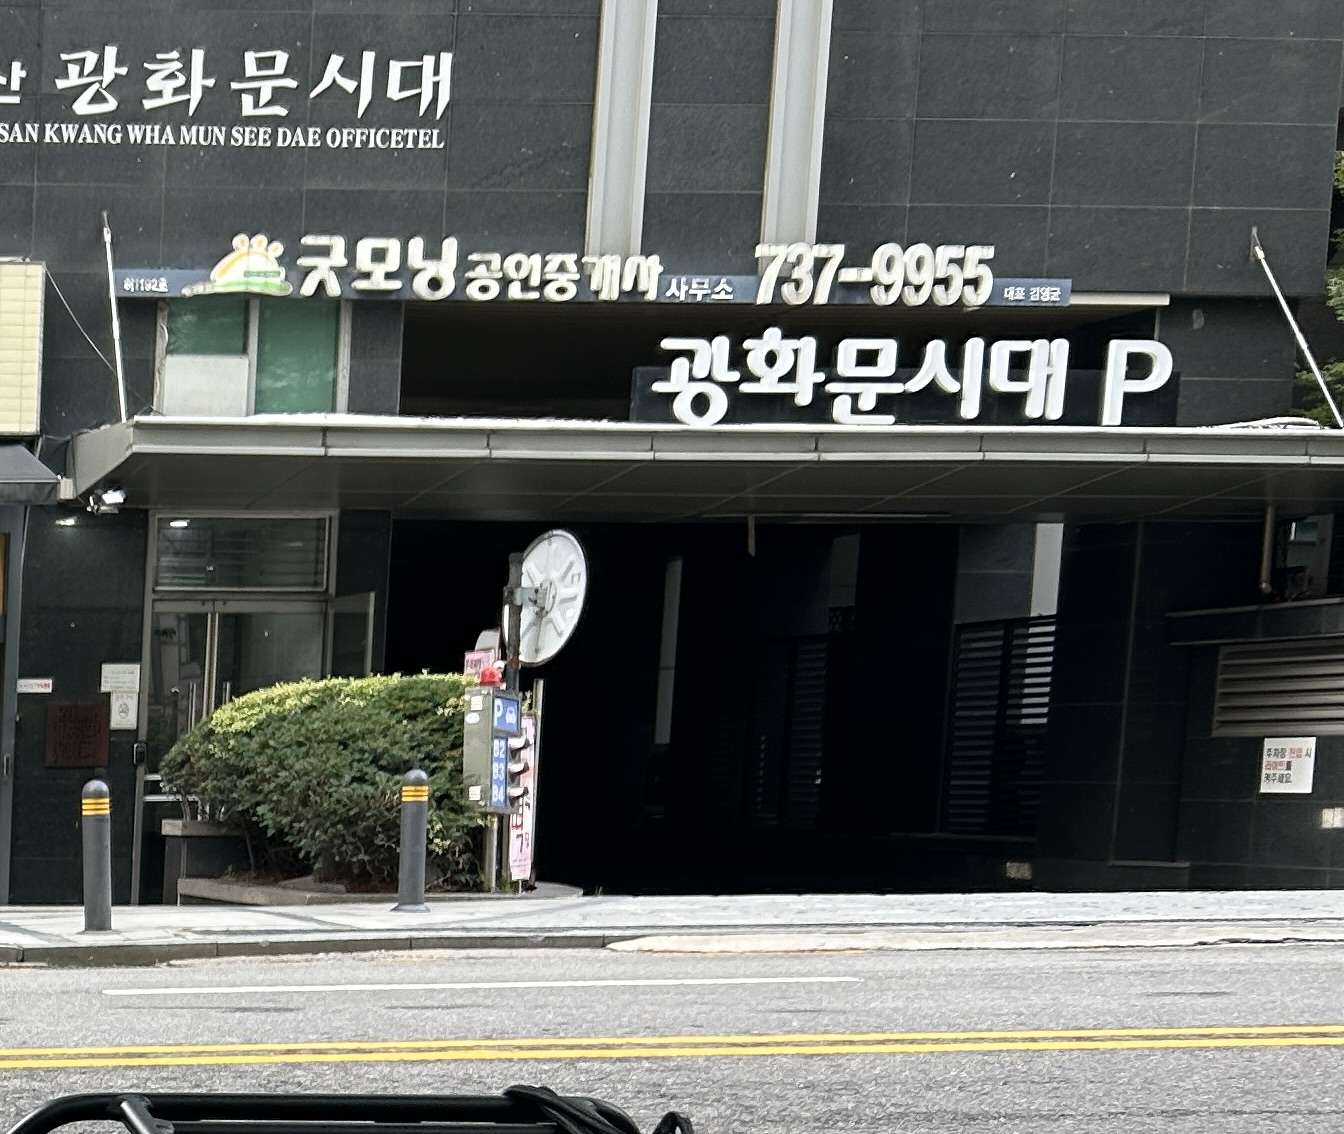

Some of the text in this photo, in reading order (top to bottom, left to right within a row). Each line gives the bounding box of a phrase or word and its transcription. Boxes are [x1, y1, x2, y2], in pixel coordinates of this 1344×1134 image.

[54, 44, 453, 120] 광화문시대
[43, 122, 123, 145] KWANG
[126, 124, 176, 145] WHA
[179, 125, 226, 147] MUN
[230, 126, 272, 147] SEE
[276, 127, 322, 148] DAE
[326, 128, 446, 149] OFFICETEL
[296, 234, 458, 301] 굿모닝
[464, 252, 664, 301] 공인중개사
[665, 277, 734, 301] 사무소
[754, 242, 995, 306] 737-9955
[652, 327, 1174, 427] 광화문시대 P
[493, 698, 503, 727] P
